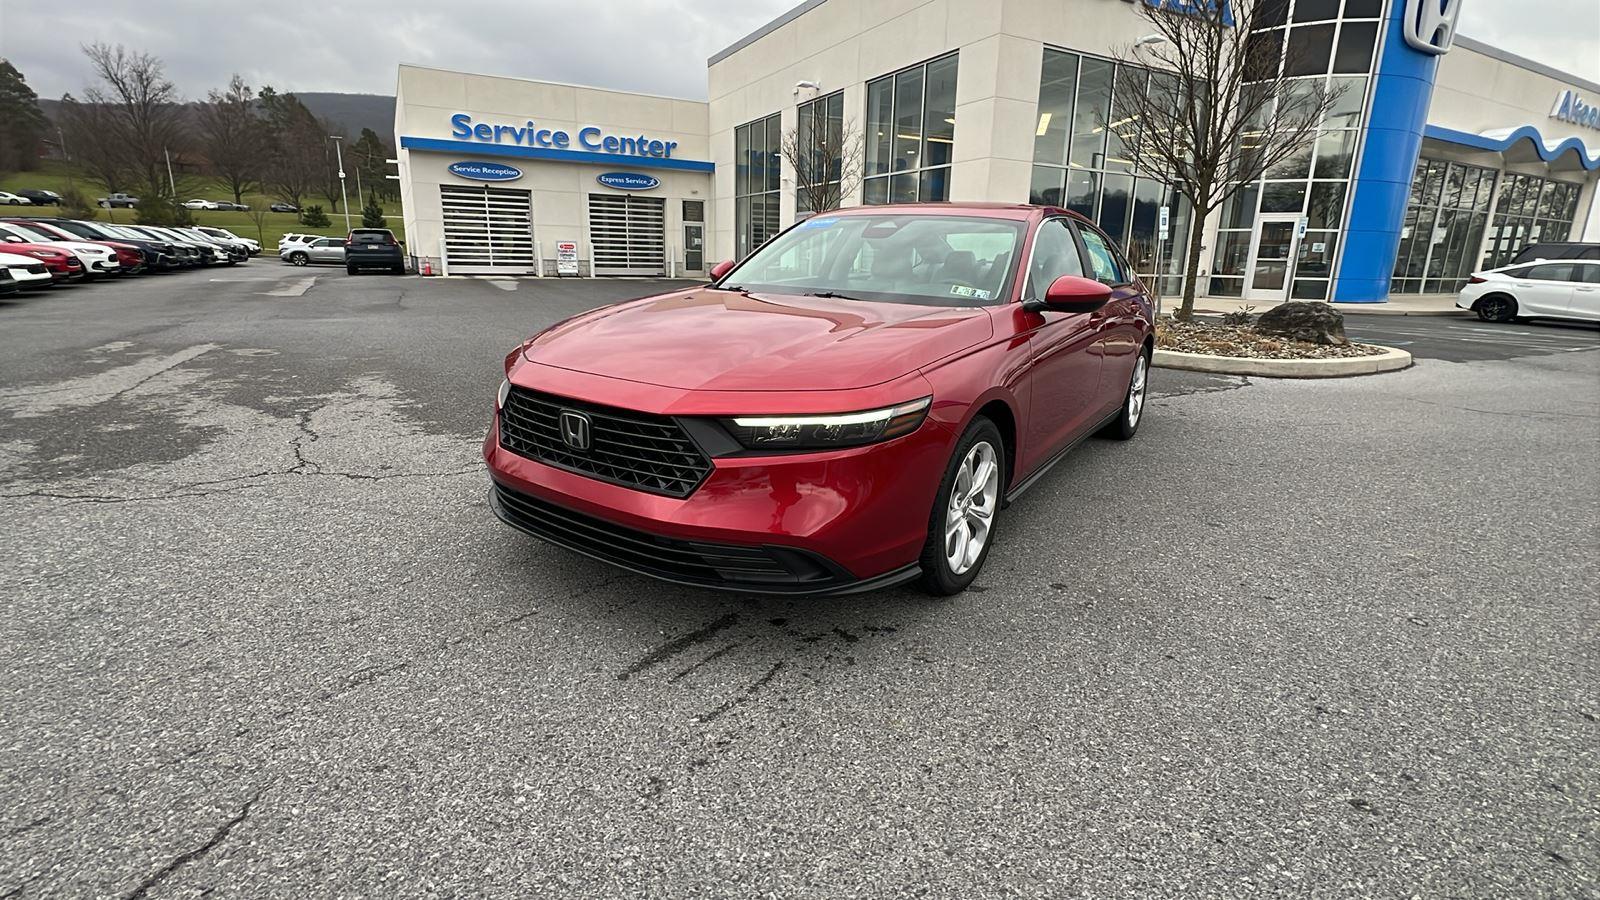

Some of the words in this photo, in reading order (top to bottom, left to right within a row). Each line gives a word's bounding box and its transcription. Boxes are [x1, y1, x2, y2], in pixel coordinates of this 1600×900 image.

[451, 113, 570, 148] Service
[578, 126, 678, 158] Center
[453, 165, 481, 174] Service
[482, 167, 518, 176] Reception
[601, 176, 624, 184] Express
[625, 177, 648, 185] Service
